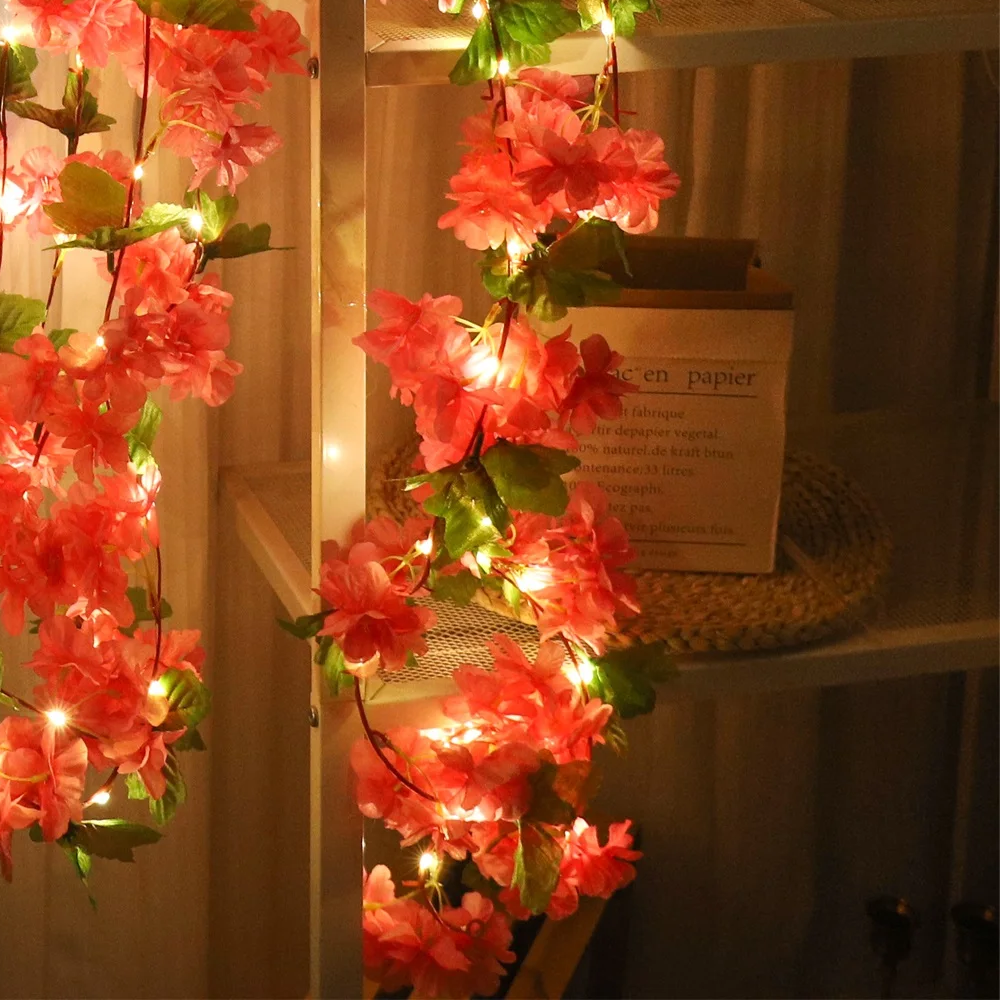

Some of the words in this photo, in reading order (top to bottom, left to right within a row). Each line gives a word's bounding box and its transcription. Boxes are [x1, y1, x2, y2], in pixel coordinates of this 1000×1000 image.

[643, 369, 669, 383] en
[687, 366, 757, 391] papier
[632, 406, 686, 421] fabrique
[670, 445, 701, 458] kraft
[704, 446, 735, 459] brun
